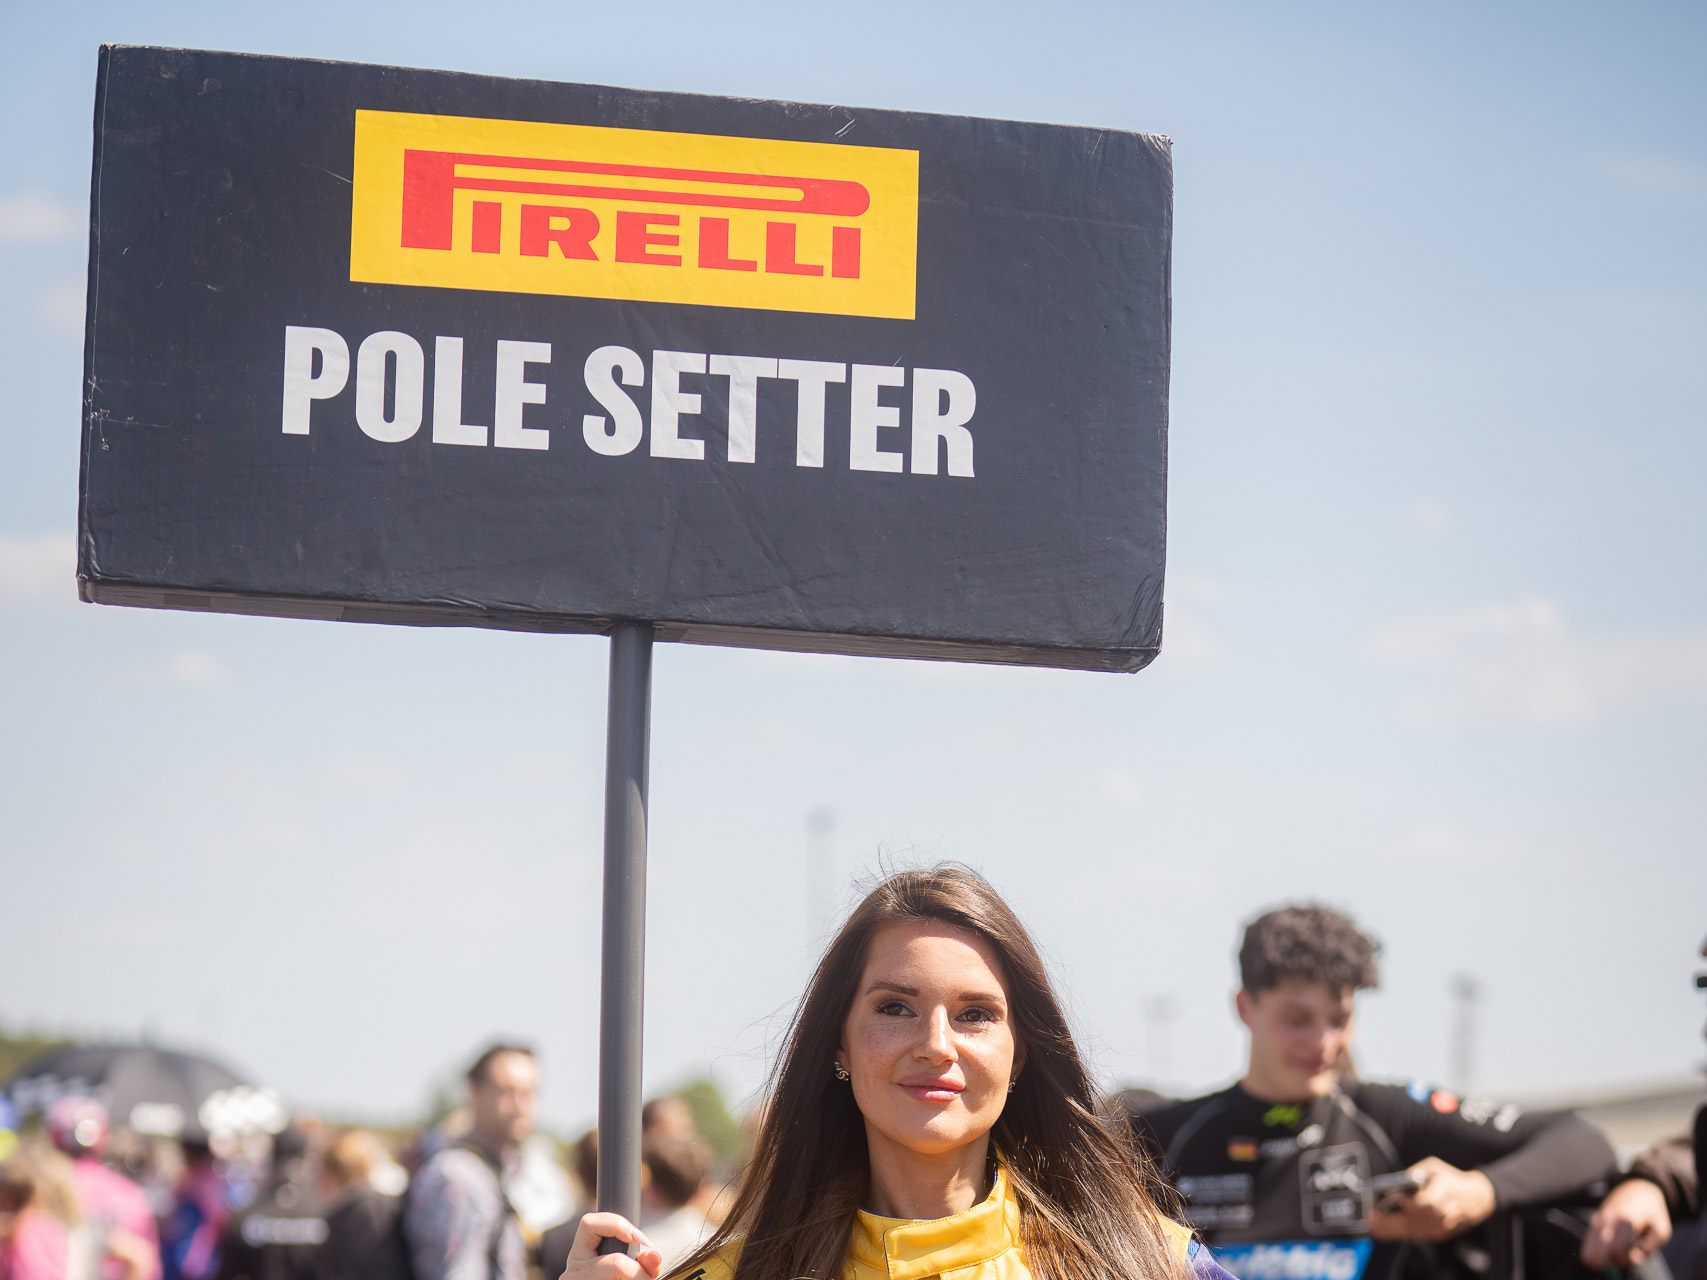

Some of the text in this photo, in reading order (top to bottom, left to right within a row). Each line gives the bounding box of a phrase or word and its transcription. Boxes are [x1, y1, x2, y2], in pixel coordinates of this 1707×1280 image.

[401, 150, 870, 278] PIRELLI
[282, 326, 976, 477] POLE SETTER
